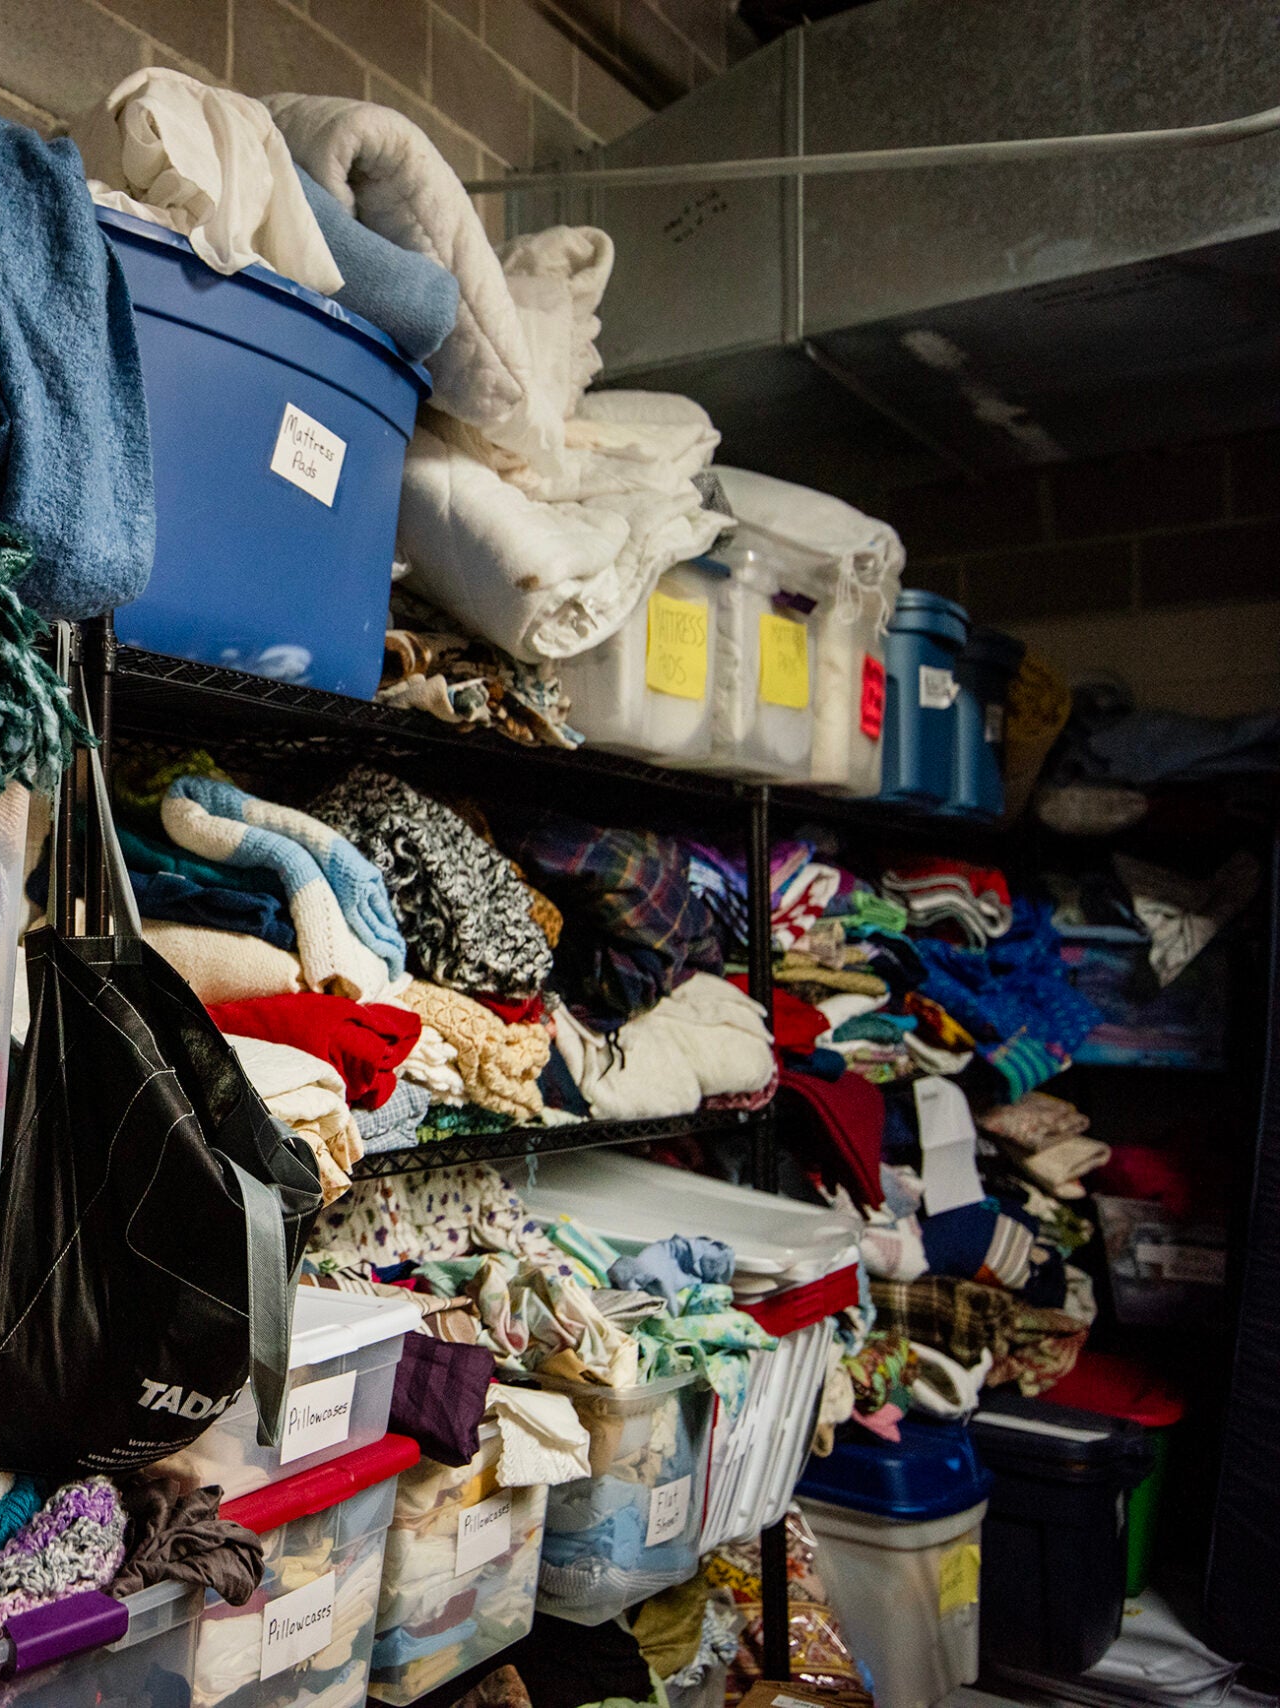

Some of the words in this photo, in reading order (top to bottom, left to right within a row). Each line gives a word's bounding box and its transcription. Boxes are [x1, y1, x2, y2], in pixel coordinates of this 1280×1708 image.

[284, 414, 335, 462] Mattress
[292, 451, 317, 479] Pads
[288, 1402, 349, 1436] Pillowcases
[268, 1604, 332, 1646] Pillowcases
